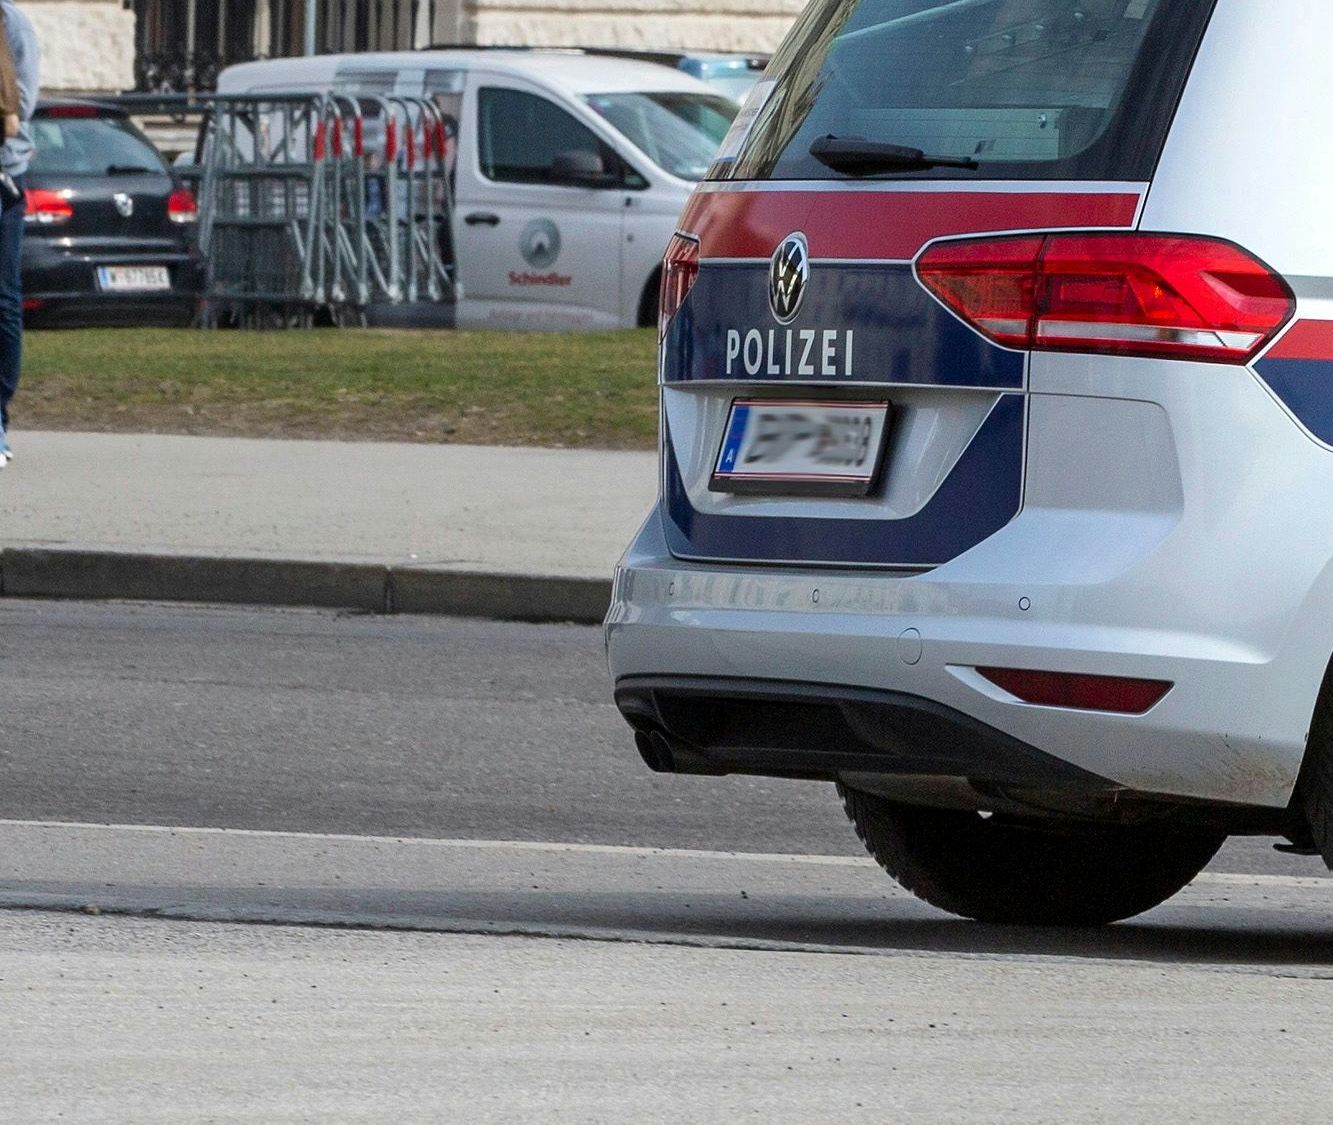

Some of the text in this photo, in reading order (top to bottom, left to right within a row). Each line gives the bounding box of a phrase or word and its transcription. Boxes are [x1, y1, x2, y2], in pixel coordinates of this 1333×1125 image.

[507, 270, 572, 286] Schindler
[726, 328, 853, 375] POLIZEI
[725, 448, 734, 463] A
